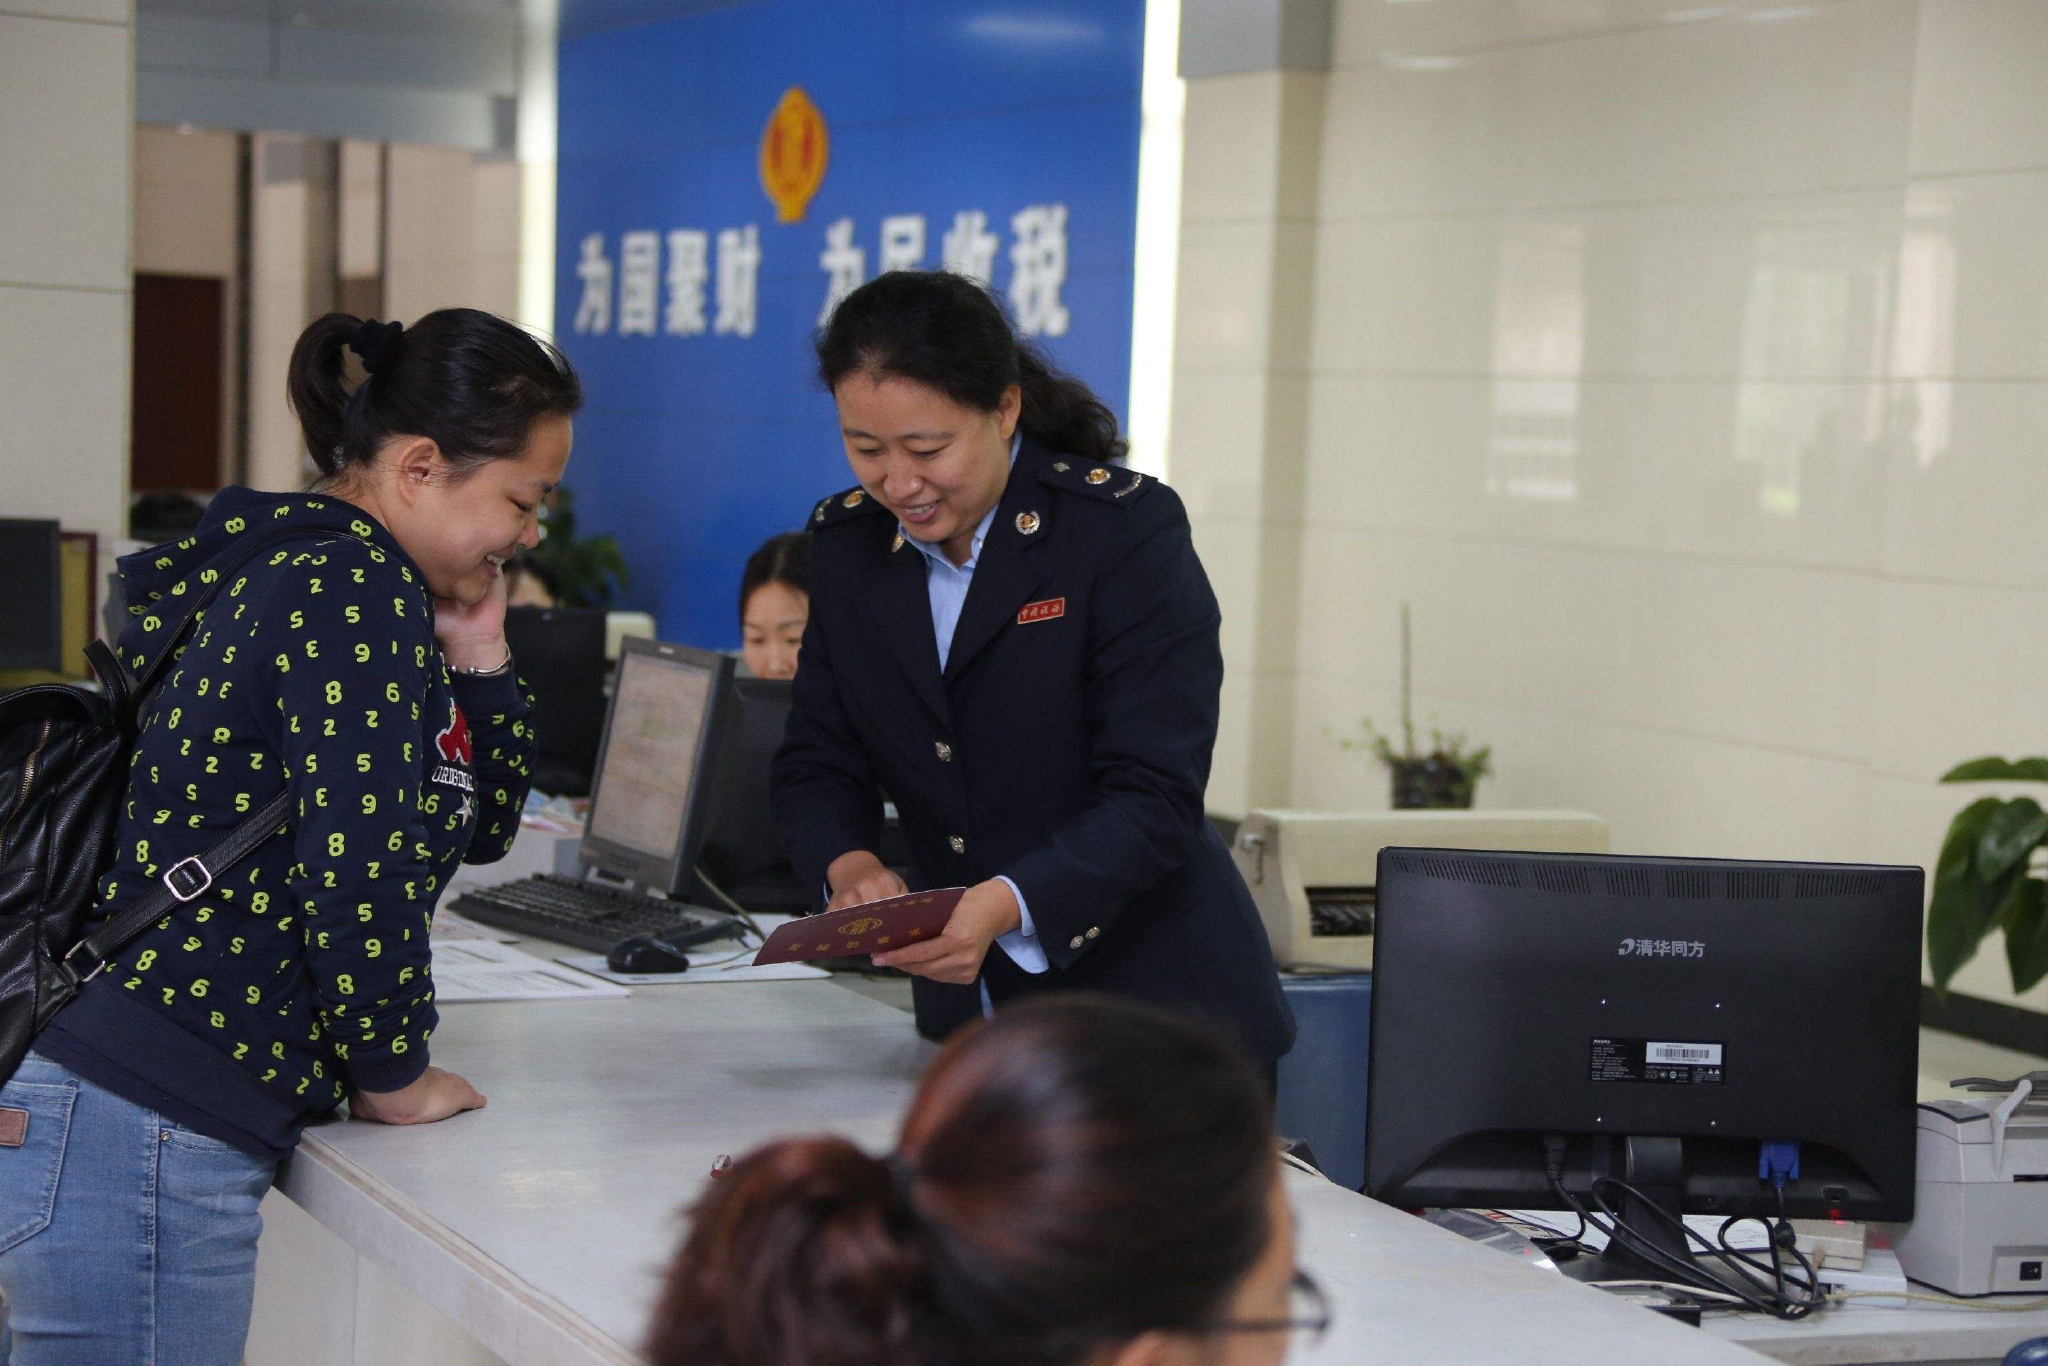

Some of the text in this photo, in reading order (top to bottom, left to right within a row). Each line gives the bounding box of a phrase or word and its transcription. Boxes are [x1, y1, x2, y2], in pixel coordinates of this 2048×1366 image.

[574, 226, 761, 337] 为国聚财
[225, 517, 245, 533] 8
[351, 520, 371, 537] 8
[231, 578, 246, 596] 8
[345, 606, 360, 623] 5
[355, 644, 370, 662] 9
[415, 646, 424, 667] 8
[326, 681, 342, 704] 8
[169, 708, 181, 729] 8
[324, 719, 336, 736] 2
[366, 711, 377, 727] 2
[206, 757, 218, 773] 2
[357, 754, 370, 772] 5
[236, 793, 250, 811] 5
[362, 794, 376, 814] 9
[425, 795, 440, 813] 6
[329, 833, 344, 856] 8
[388, 831, 402, 851] 6
[137, 840, 149, 863] 8
[324, 871, 336, 887] 2
[368, 862, 379, 878] 2
[251, 892, 269, 913] 8
[358, 904, 372, 921] 5
[365, 939, 381, 957] 9
[1636, 939, 1706, 958] 清华同方
[136, 950, 157, 970] 8
[337, 974, 353, 994] 8
[392, 1035, 407, 1053] 6
